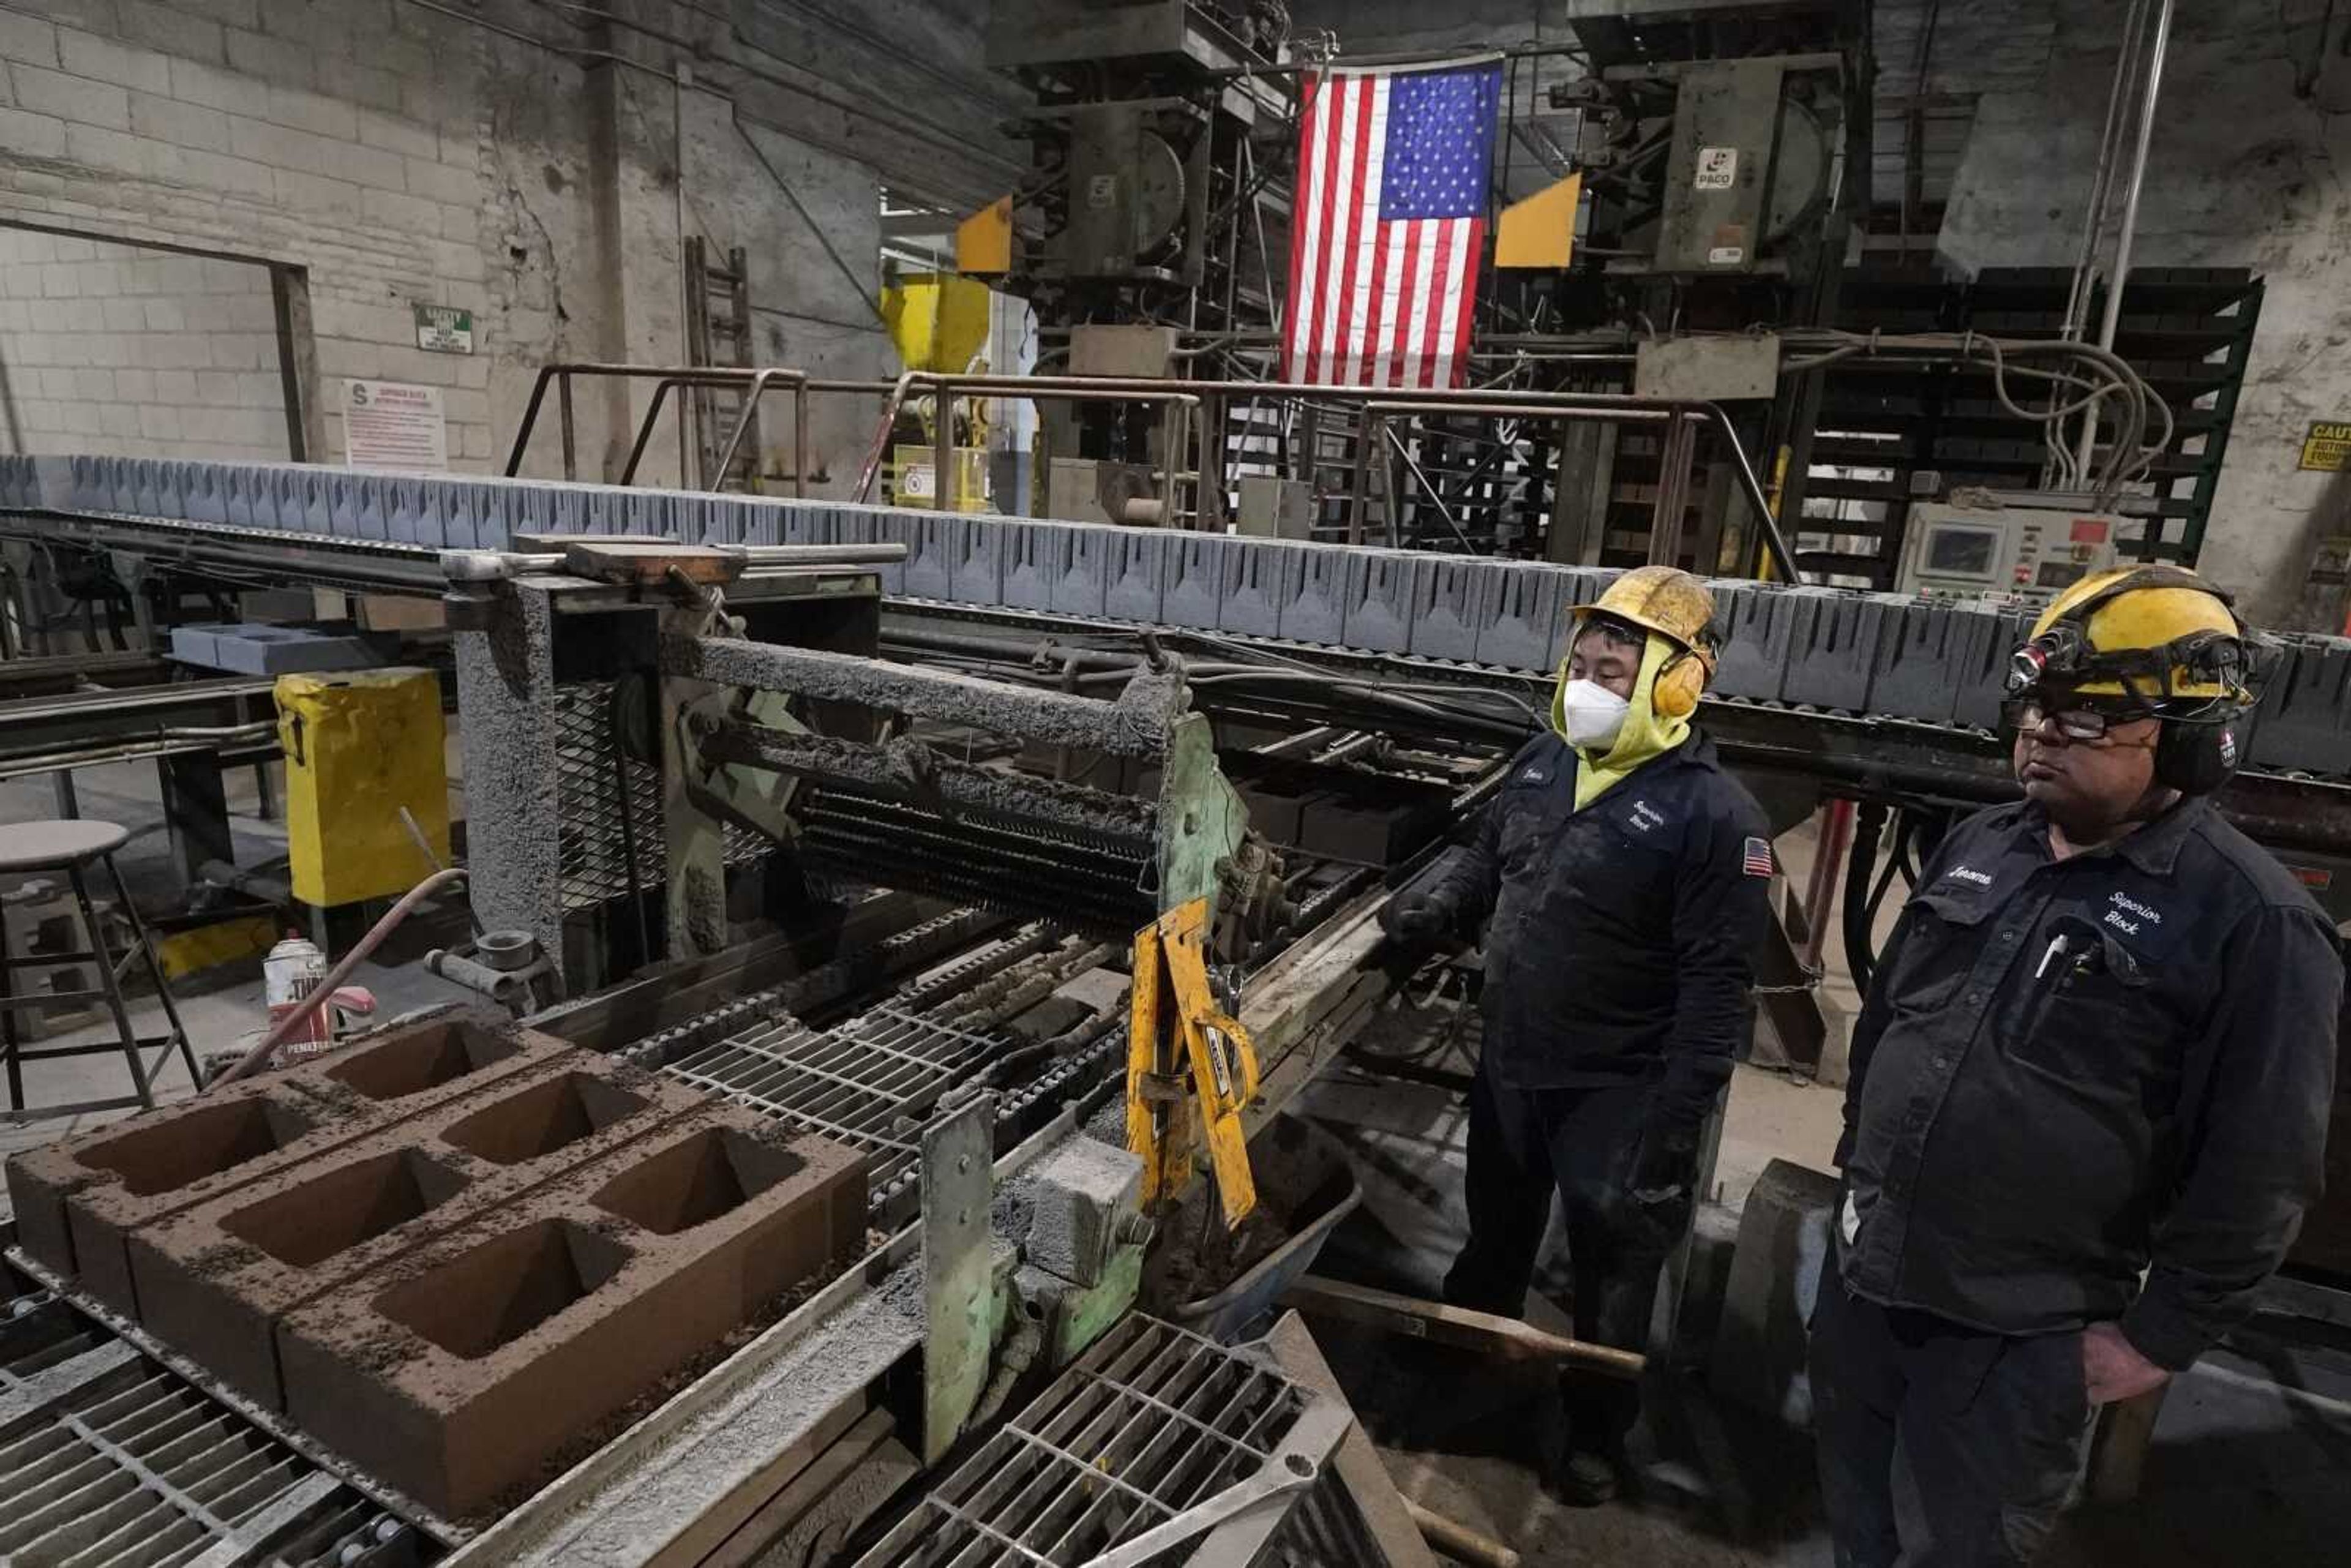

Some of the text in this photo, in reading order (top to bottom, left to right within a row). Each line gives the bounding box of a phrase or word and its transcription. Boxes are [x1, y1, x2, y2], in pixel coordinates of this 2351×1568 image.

[1700, 174, 1730, 183] PACO
[2109, 891, 2162, 924] Superior
[2104, 910, 2139, 936] Block
